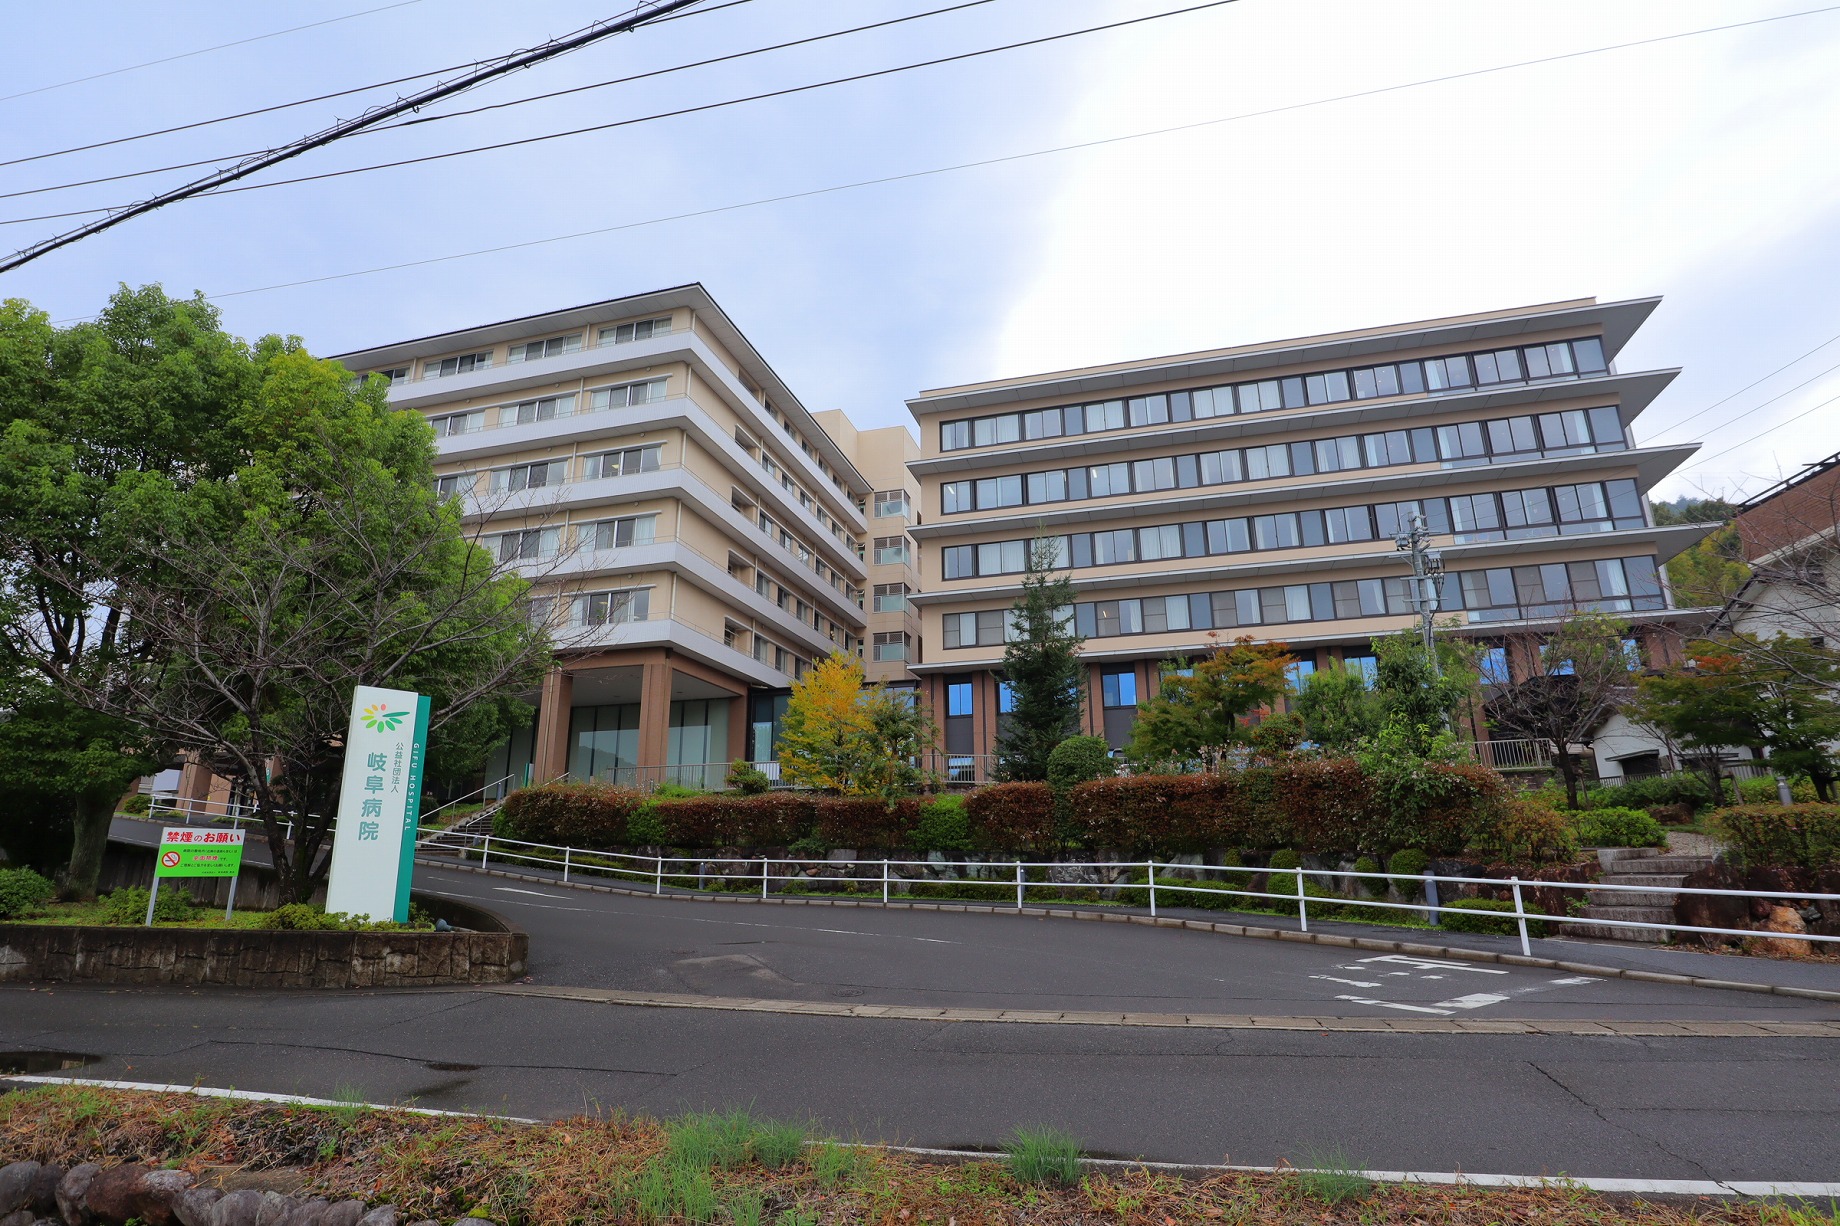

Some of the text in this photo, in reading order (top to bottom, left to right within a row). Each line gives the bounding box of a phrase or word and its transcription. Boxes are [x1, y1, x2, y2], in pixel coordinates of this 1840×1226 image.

[358, 751, 388, 841] 岐阜病院
[391, 742, 404, 793] 公益社団法人
[404, 743, 419, 830] GIFU HOSPITAL
[166, 831, 240, 843] 禁煙のお願い
